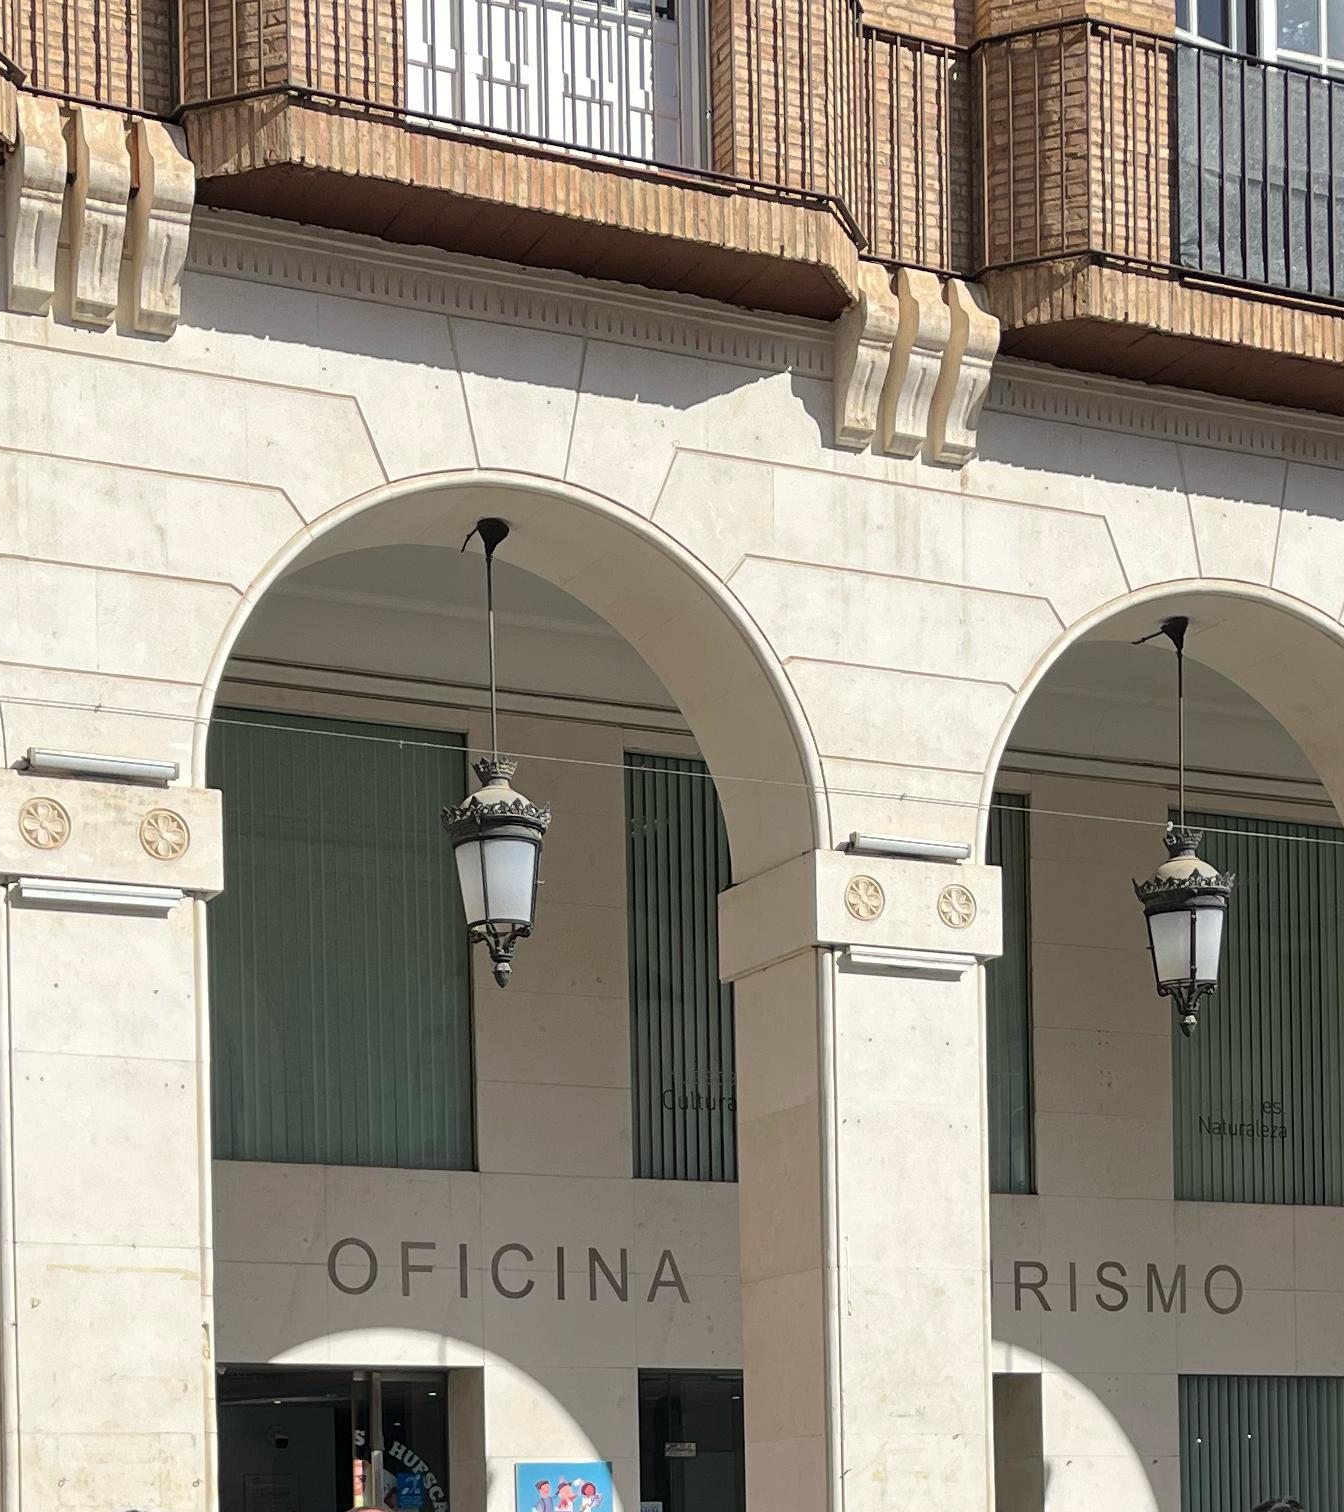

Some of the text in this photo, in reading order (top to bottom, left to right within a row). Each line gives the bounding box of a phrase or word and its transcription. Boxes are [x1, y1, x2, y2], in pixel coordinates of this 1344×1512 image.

[663, 1088, 736, 1112] Cultura
[1199, 1115, 1288, 1139] Naturaleza
[327, 1237, 1244, 1315] OFICINA RISMO
